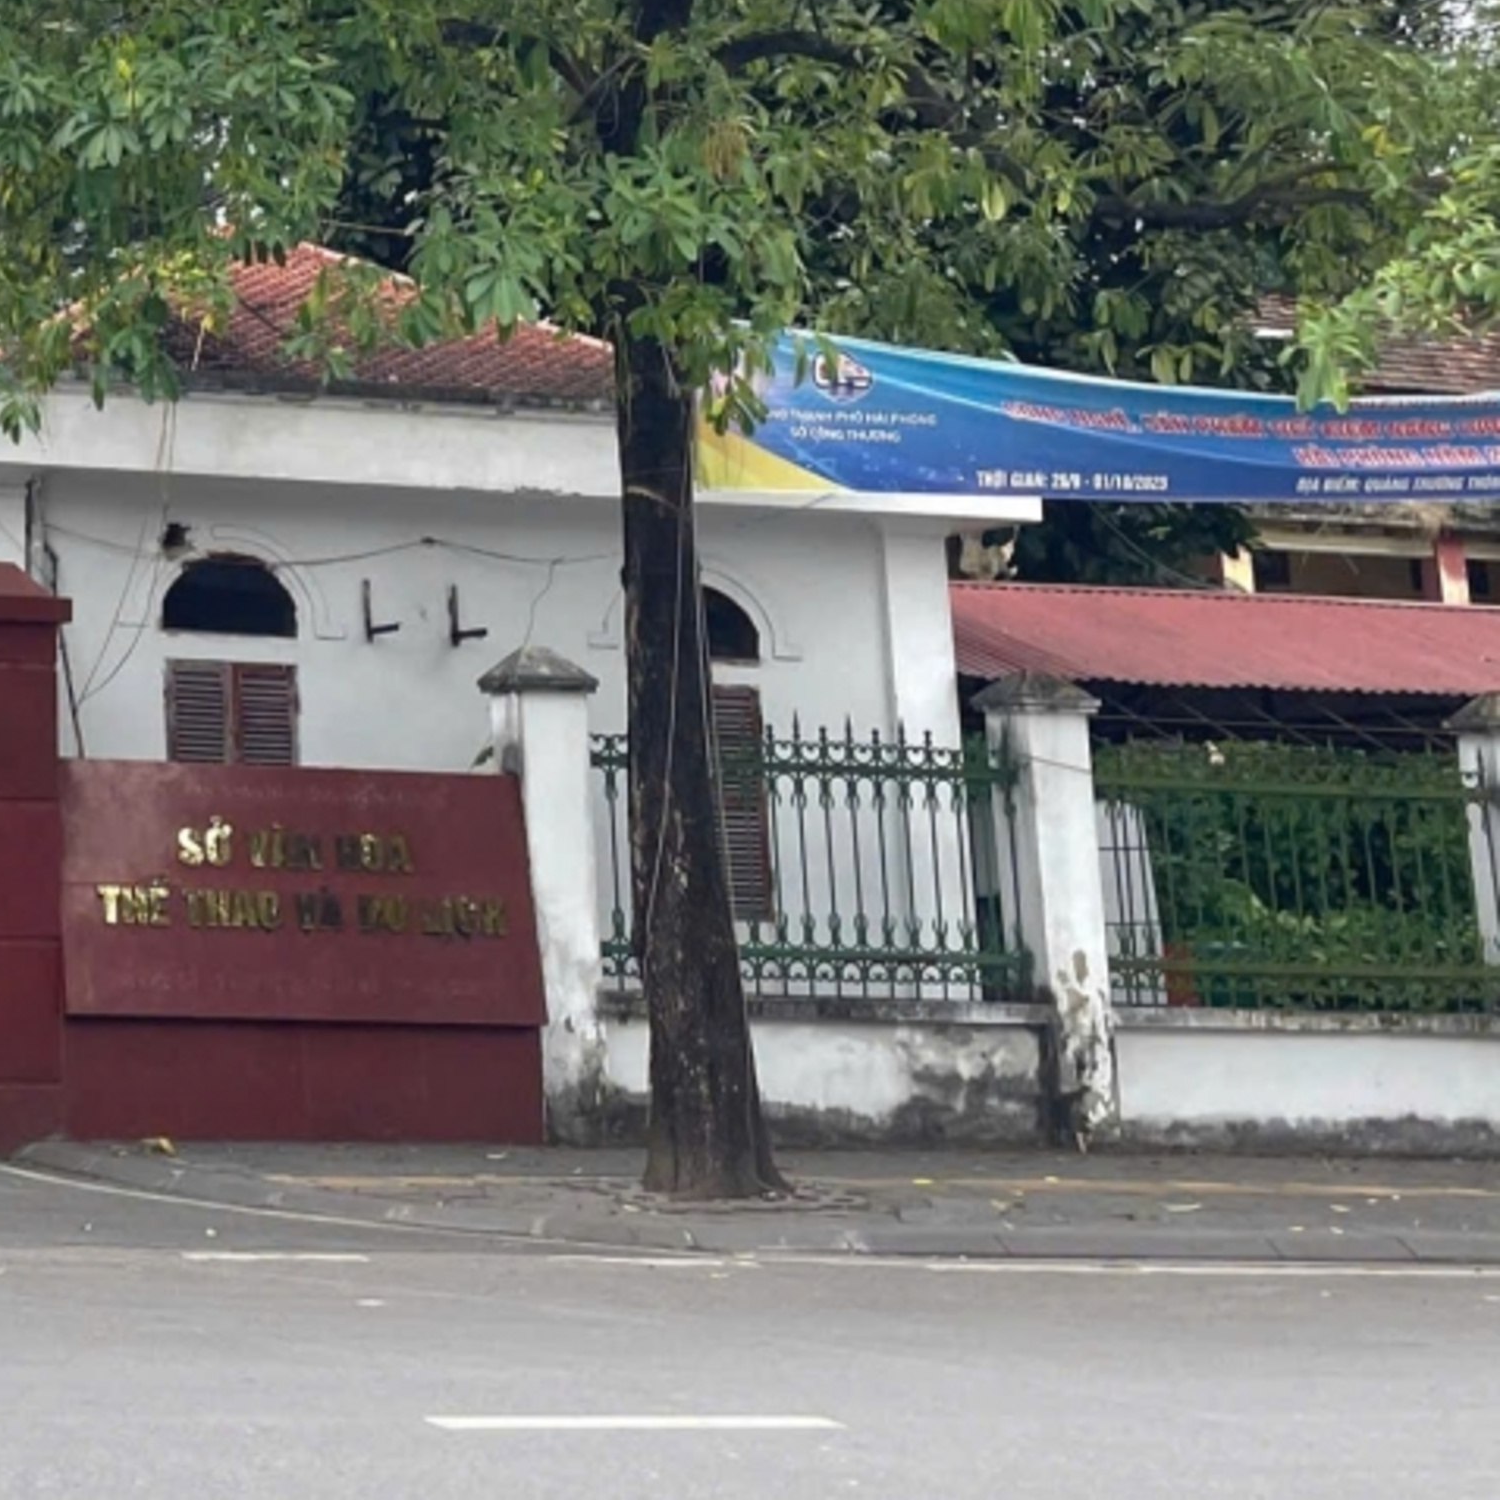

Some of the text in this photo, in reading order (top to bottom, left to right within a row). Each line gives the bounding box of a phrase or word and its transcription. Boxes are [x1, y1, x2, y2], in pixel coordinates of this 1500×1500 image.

[177, 815, 232, 866] SỞ
[97, 874, 171, 928] THỂ
[185, 885, 282, 932] THAO
[296, 886, 343, 932] VÀ
[357, 893, 407, 934] DU
